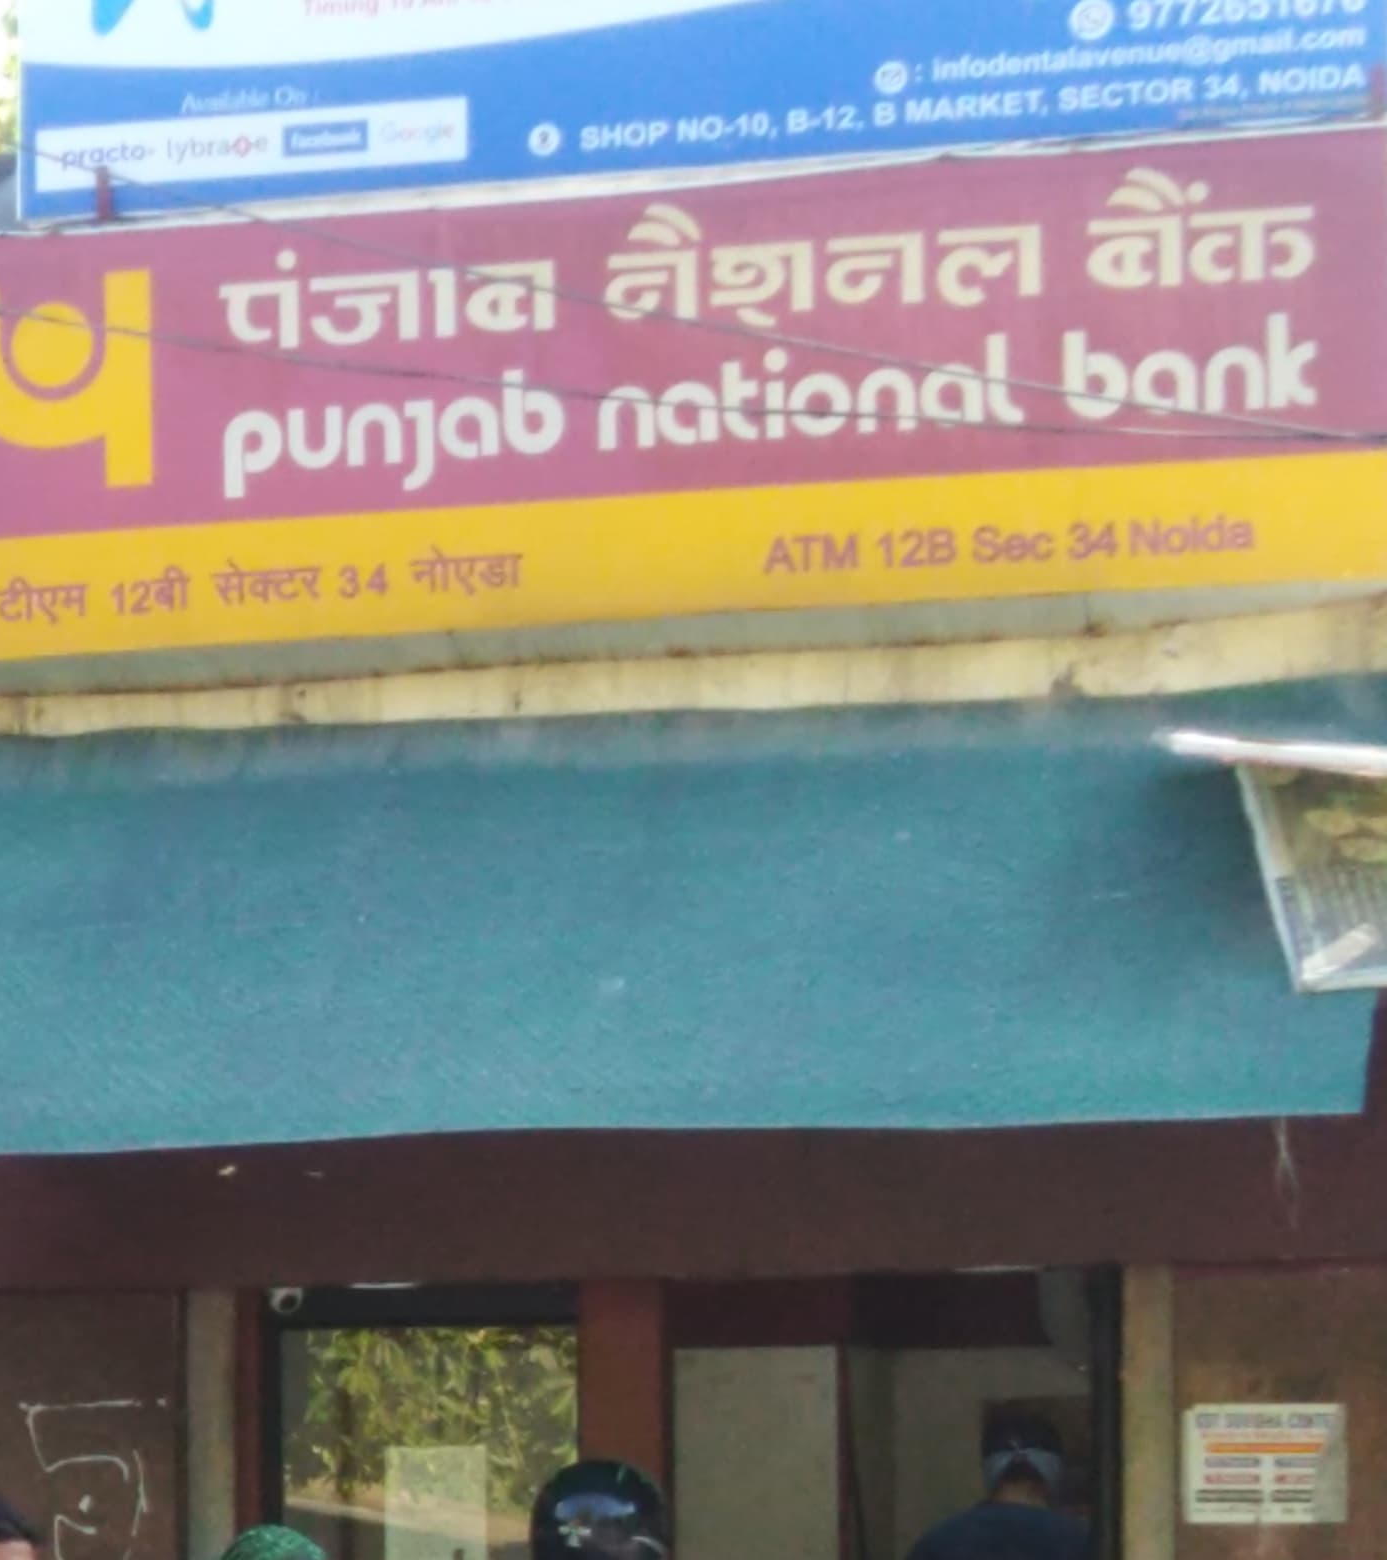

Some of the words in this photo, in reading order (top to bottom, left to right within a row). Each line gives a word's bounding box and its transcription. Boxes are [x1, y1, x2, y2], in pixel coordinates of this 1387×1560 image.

[580, 123, 669, 152] SHOP
[873, 102, 897, 128] B
[905, 90, 1050, 124] MARKET,
[1057, 79, 1194, 113] SECTOR
[1258, 63, 1366, 92] NOIDA
[219, 250, 558, 350] पंजाब
[1085, 166, 1317, 290] बैंक
[222, 369, 567, 500] punjab
[594, 327, 1025, 453] national
[1059, 312, 1320, 419] bank
[337, 563, 389, 599] 34
[762, 532, 860, 575] ATM
[875, 526, 958, 569] 12B
[970, 524, 1055, 564] Sec
[1067, 520, 1119, 561] 34
[1129, 513, 1256, 556] Noida
